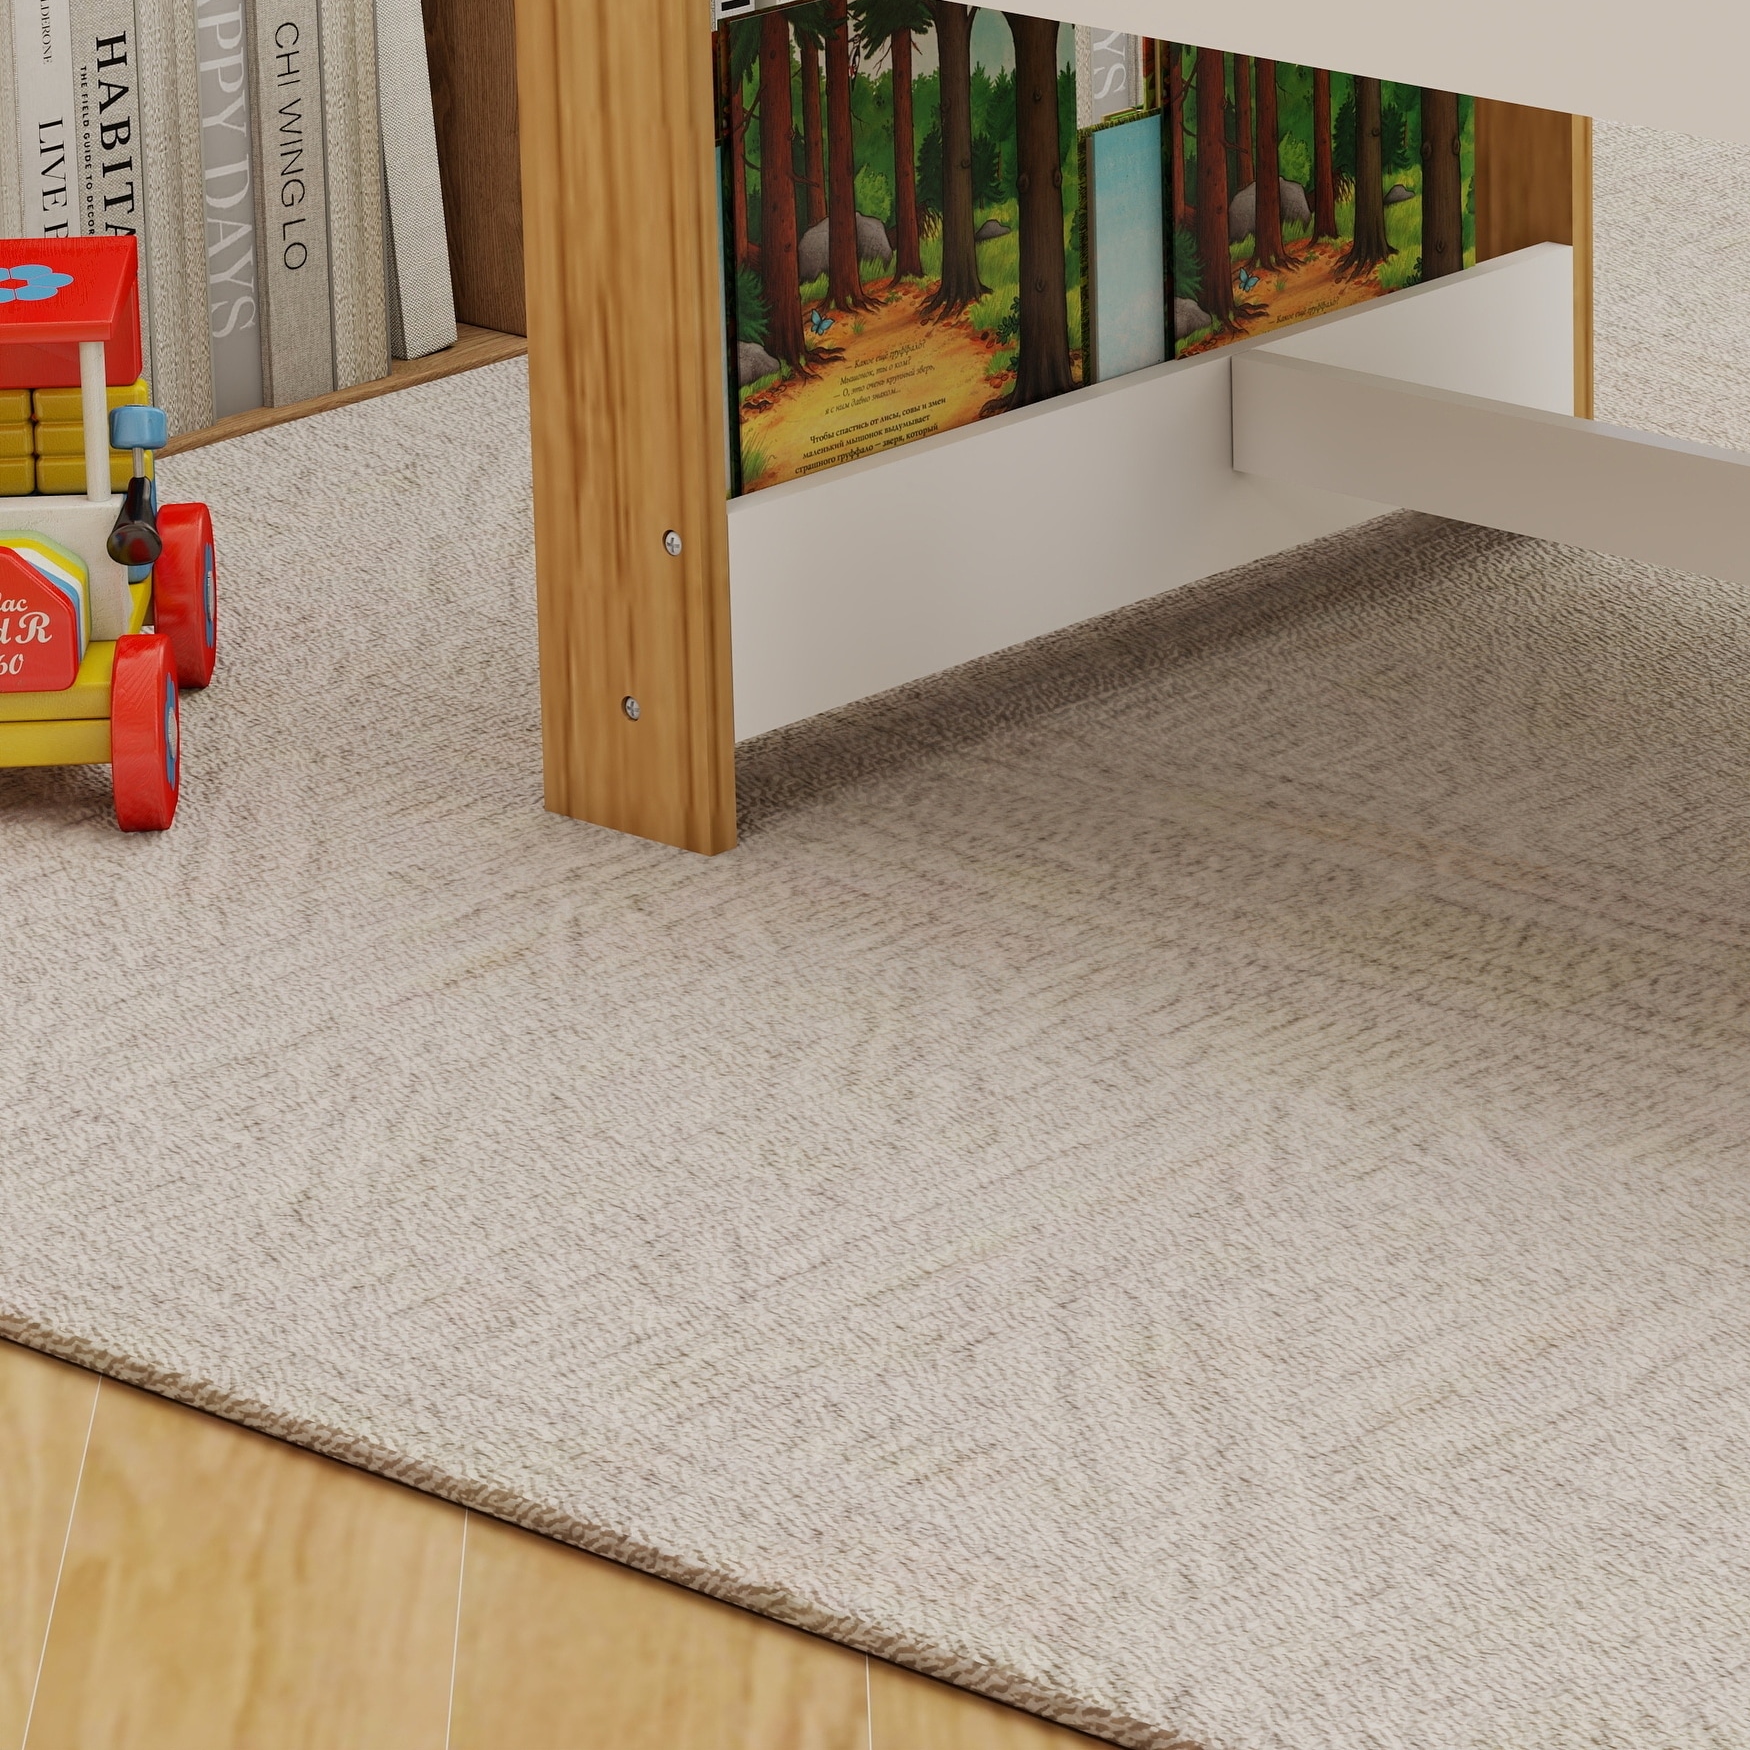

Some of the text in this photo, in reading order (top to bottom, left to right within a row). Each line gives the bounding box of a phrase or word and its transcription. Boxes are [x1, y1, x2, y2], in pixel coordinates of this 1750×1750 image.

[80, 65, 88, 88] THE
[274, 21, 300, 88] CHI
[81, 93, 90, 126] FIELD
[38, 117, 68, 212] LIVE
[83, 132, 92, 170] GUIDE
[278, 98, 306, 208] WING
[85, 174, 93, 189] TO
[204, 153, 257, 339] DAYS
[282, 218, 308, 271] LO
[802, 414, 931, 460] маленький мышонок выдумывает
[810, 430, 835, 444] Чтобы
[835, 421, 870, 437] спастись
[870, 417, 880, 426] от
[879, 411, 901, 425] лисы,
[902, 405, 921, 416] совы
[794, 456, 836, 475] страшного
[836, 444, 874, 463] груффало
[905, 423, 939, 441] который
[15, 611, 52, 644] R
